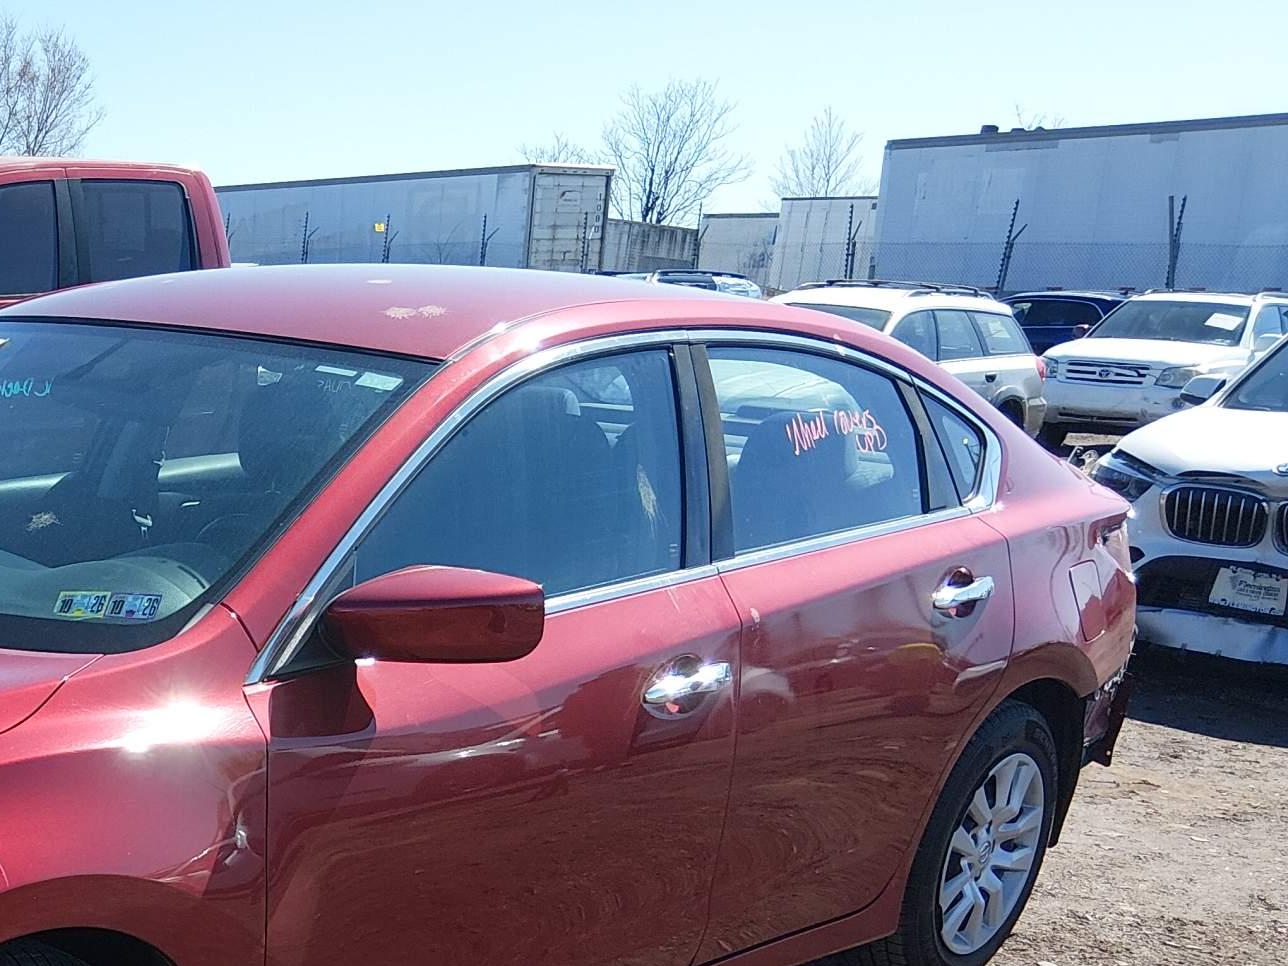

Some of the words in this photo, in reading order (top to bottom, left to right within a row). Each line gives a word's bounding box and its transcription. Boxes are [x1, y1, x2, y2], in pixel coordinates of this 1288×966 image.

[59, 599, 73, 613] 10
[91, 595, 108, 614] 26
[110, 600, 125, 615] 10
[142, 598, 159, 616] 26
